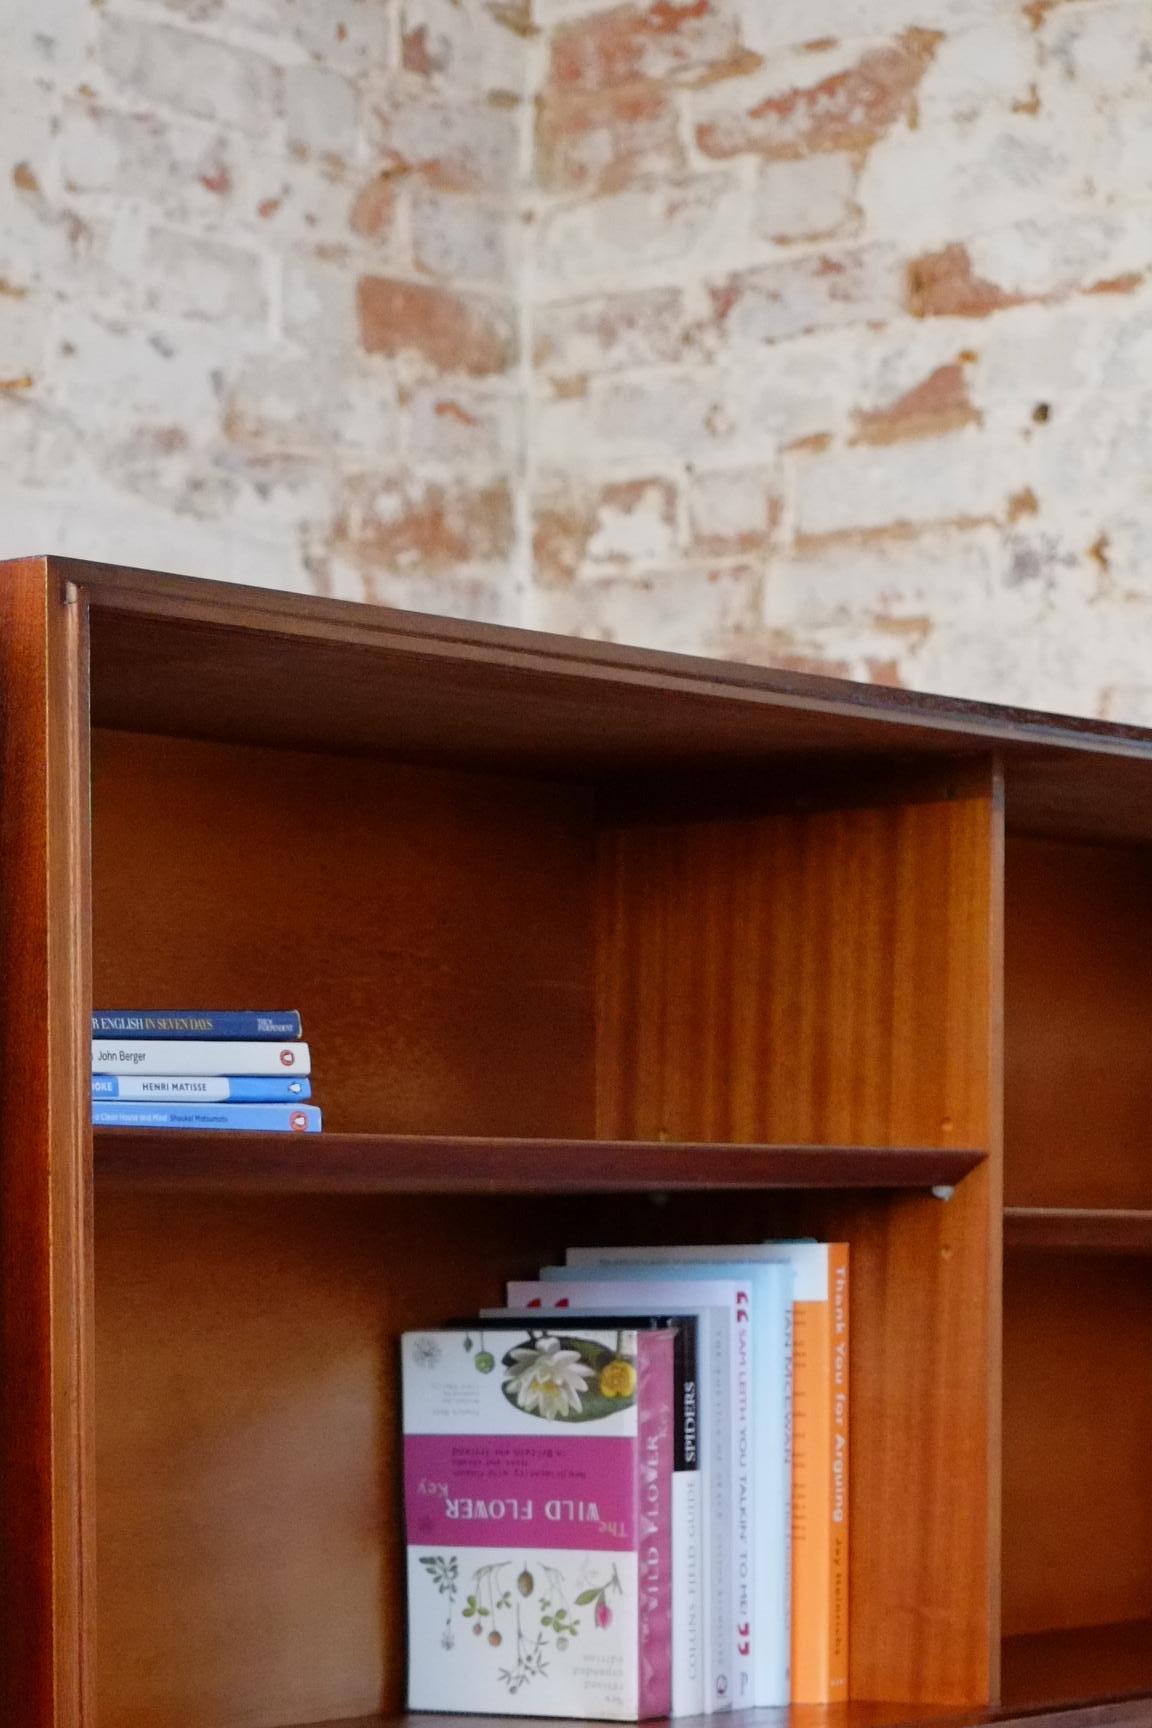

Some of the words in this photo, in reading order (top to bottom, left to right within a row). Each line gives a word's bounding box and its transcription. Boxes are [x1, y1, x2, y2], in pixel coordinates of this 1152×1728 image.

[101, 1018, 144, 1030] ENGLISH
[145, 1018, 155, 1030] IN
[158, 1018, 189, 1030] SEVEN
[190, 1019, 212, 1030] DAYS
[98, 1050, 117, 1061] John
[119, 1050, 146, 1064] Berger
[142, 1083, 168, 1091] HENRI
[172, 1083, 207, 1091] MATISSE
[835, 1266, 846, 1334] Thank
[739, 1328, 747, 1366] SAM
[835, 1342, 845, 1384] You
[684, 1382, 696, 1462] SPIDERS
[835, 1393, 846, 1427] for
[739, 1426, 747, 1466] YOU
[417, 1478, 449, 1499] Key
[647, 1437, 659, 1533] FLOWER
[832, 1434, 846, 1522] Arguing
[445, 1499, 533, 1520] FLOWER
[544, 1499, 599, 1521] WILD
[687, 1480, 696, 1536] GUIDE
[599, 1521, 626, 1537] The
[647, 1547, 659, 1611] WILD
[688, 1545, 696, 1594] FIELD
[740, 1553, 747, 1578] TO
[688, 1602, 696, 1680] COLLINS
